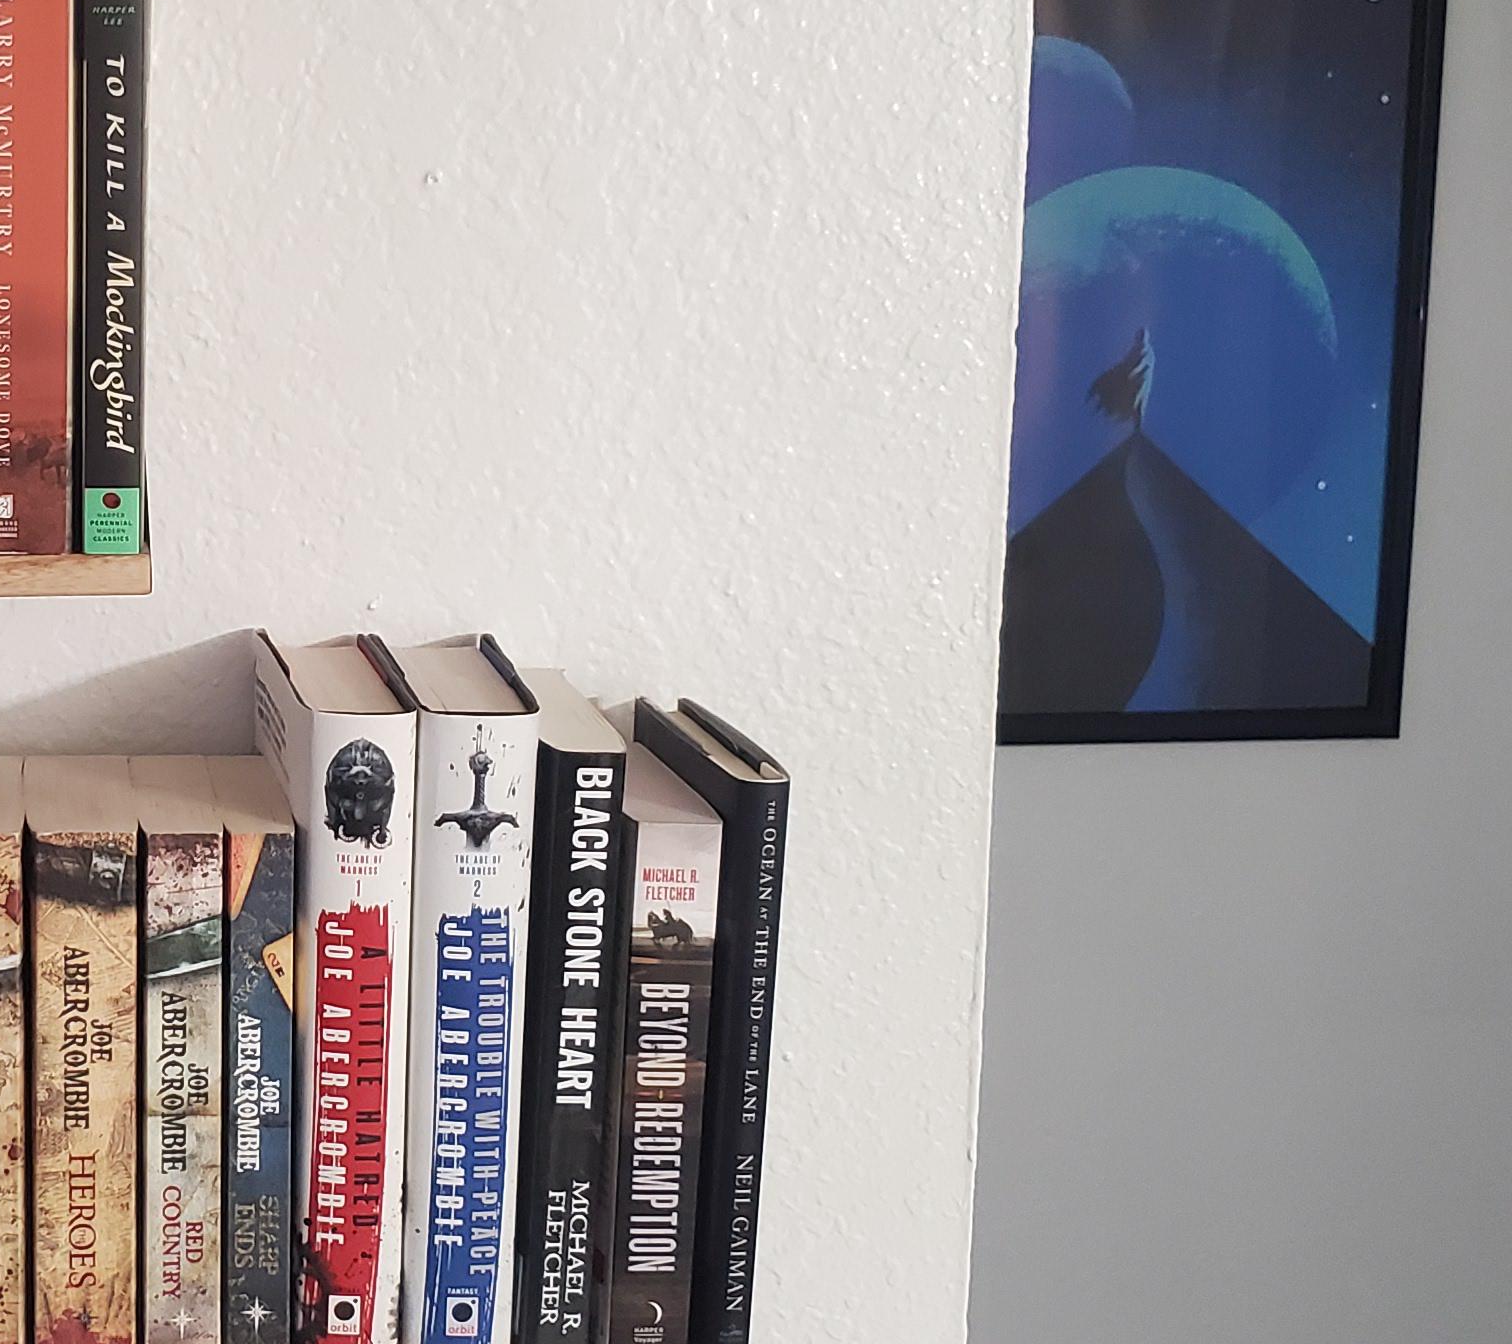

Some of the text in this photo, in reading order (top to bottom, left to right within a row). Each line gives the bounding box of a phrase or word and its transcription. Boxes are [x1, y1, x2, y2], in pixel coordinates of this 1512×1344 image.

[90, 54, 135, 453] TO KILL A Mockingbird
[643, 868, 687, 883] MICHAEL
[645, 886, 695, 901] FLETCHER
[758, 828, 776, 901] OCEAN
[555, 767, 613, 1109] BLACK STONE HEART
[750, 976, 766, 1019] END
[753, 925, 777, 969] THE
[469, 918, 506, 1275] THE TROUBLE WITH PEACE
[627, 982, 690, 1272] BEYOND REDEMPTION
[68, 1149, 97, 1289] HEROES
[162, 1185, 182, 1299] COUNTRY
[186, 1221, 204, 1264] RED
[726, 1068, 759, 1311] LANE NEIL GAIMAN
[539, 1190, 566, 1325] FLETCHER
[561, 1180, 590, 1335] MICHAEL R.
